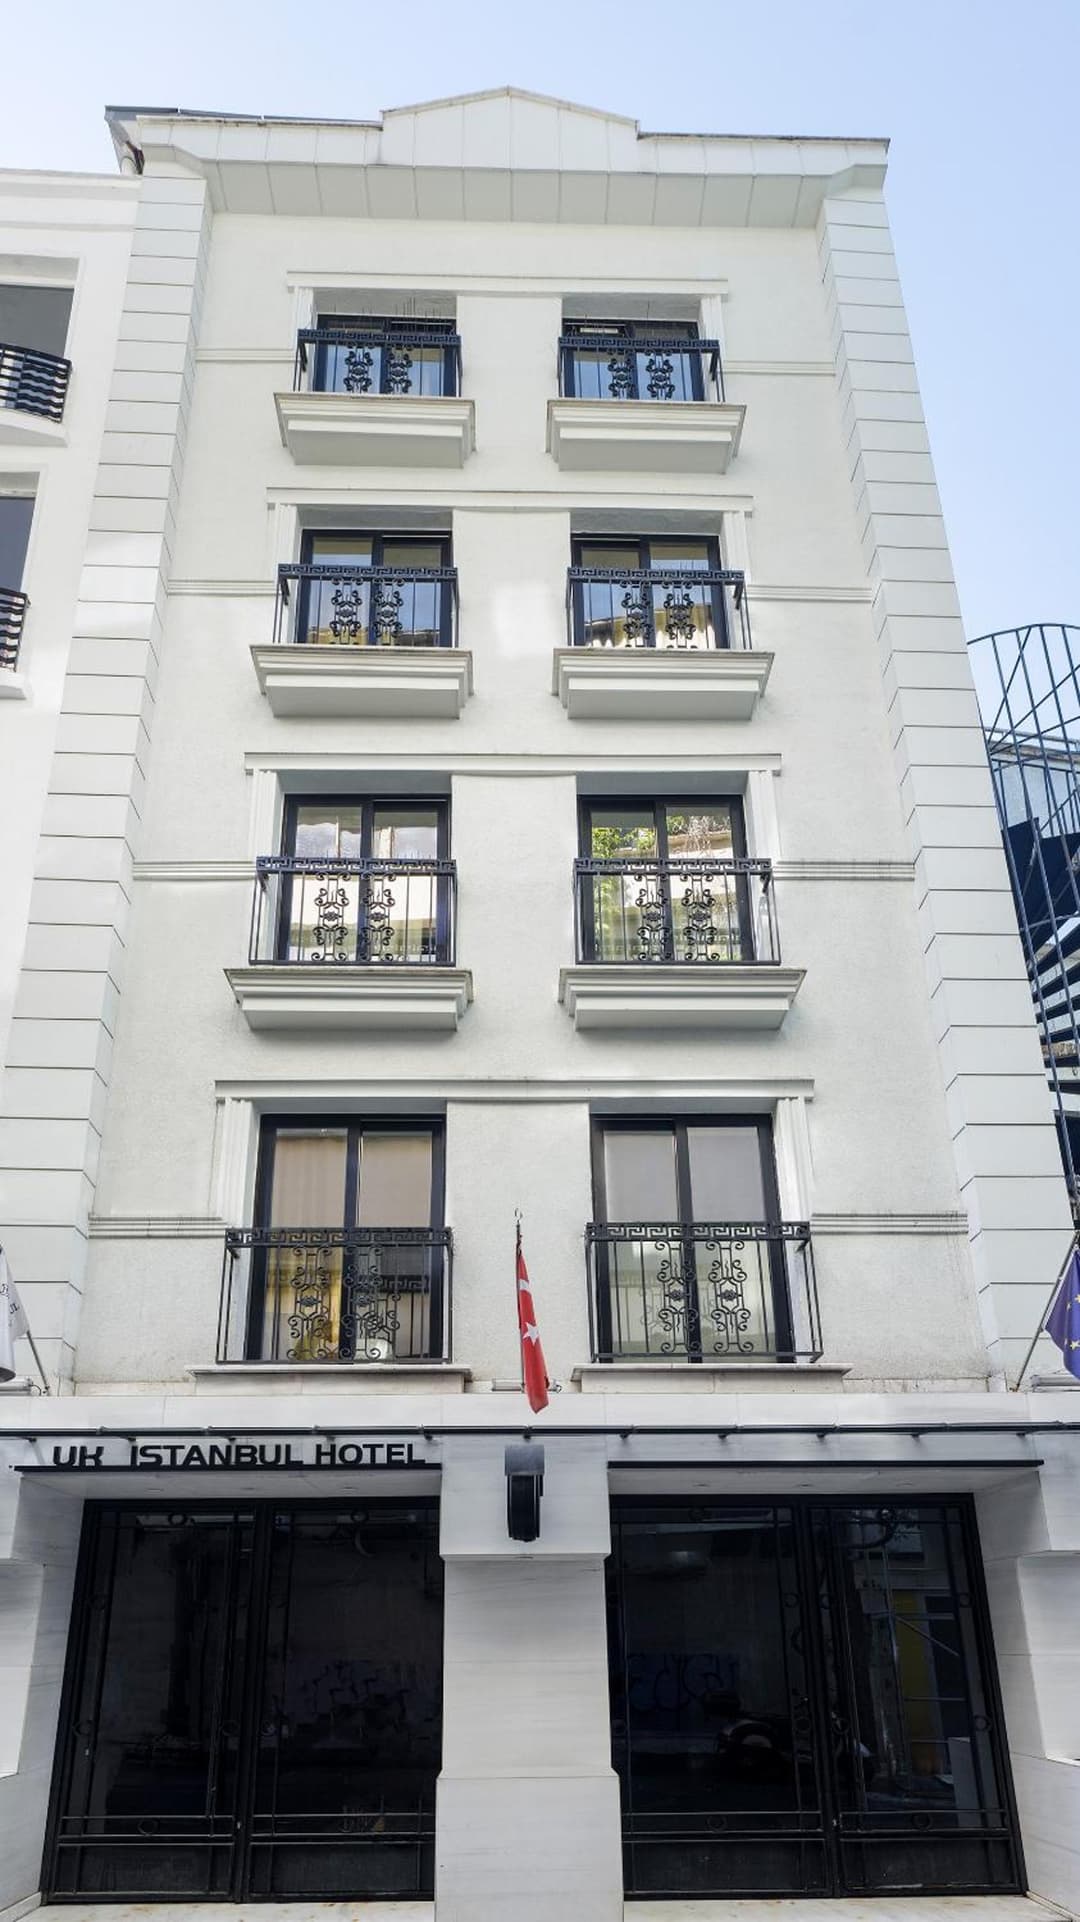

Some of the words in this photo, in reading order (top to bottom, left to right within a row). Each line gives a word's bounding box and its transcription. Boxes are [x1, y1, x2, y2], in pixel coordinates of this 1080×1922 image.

[53, 1446, 104, 1468] UK
[131, 1444, 304, 1467] ISTANBUL
[315, 1443, 426, 1466] HOTEL
